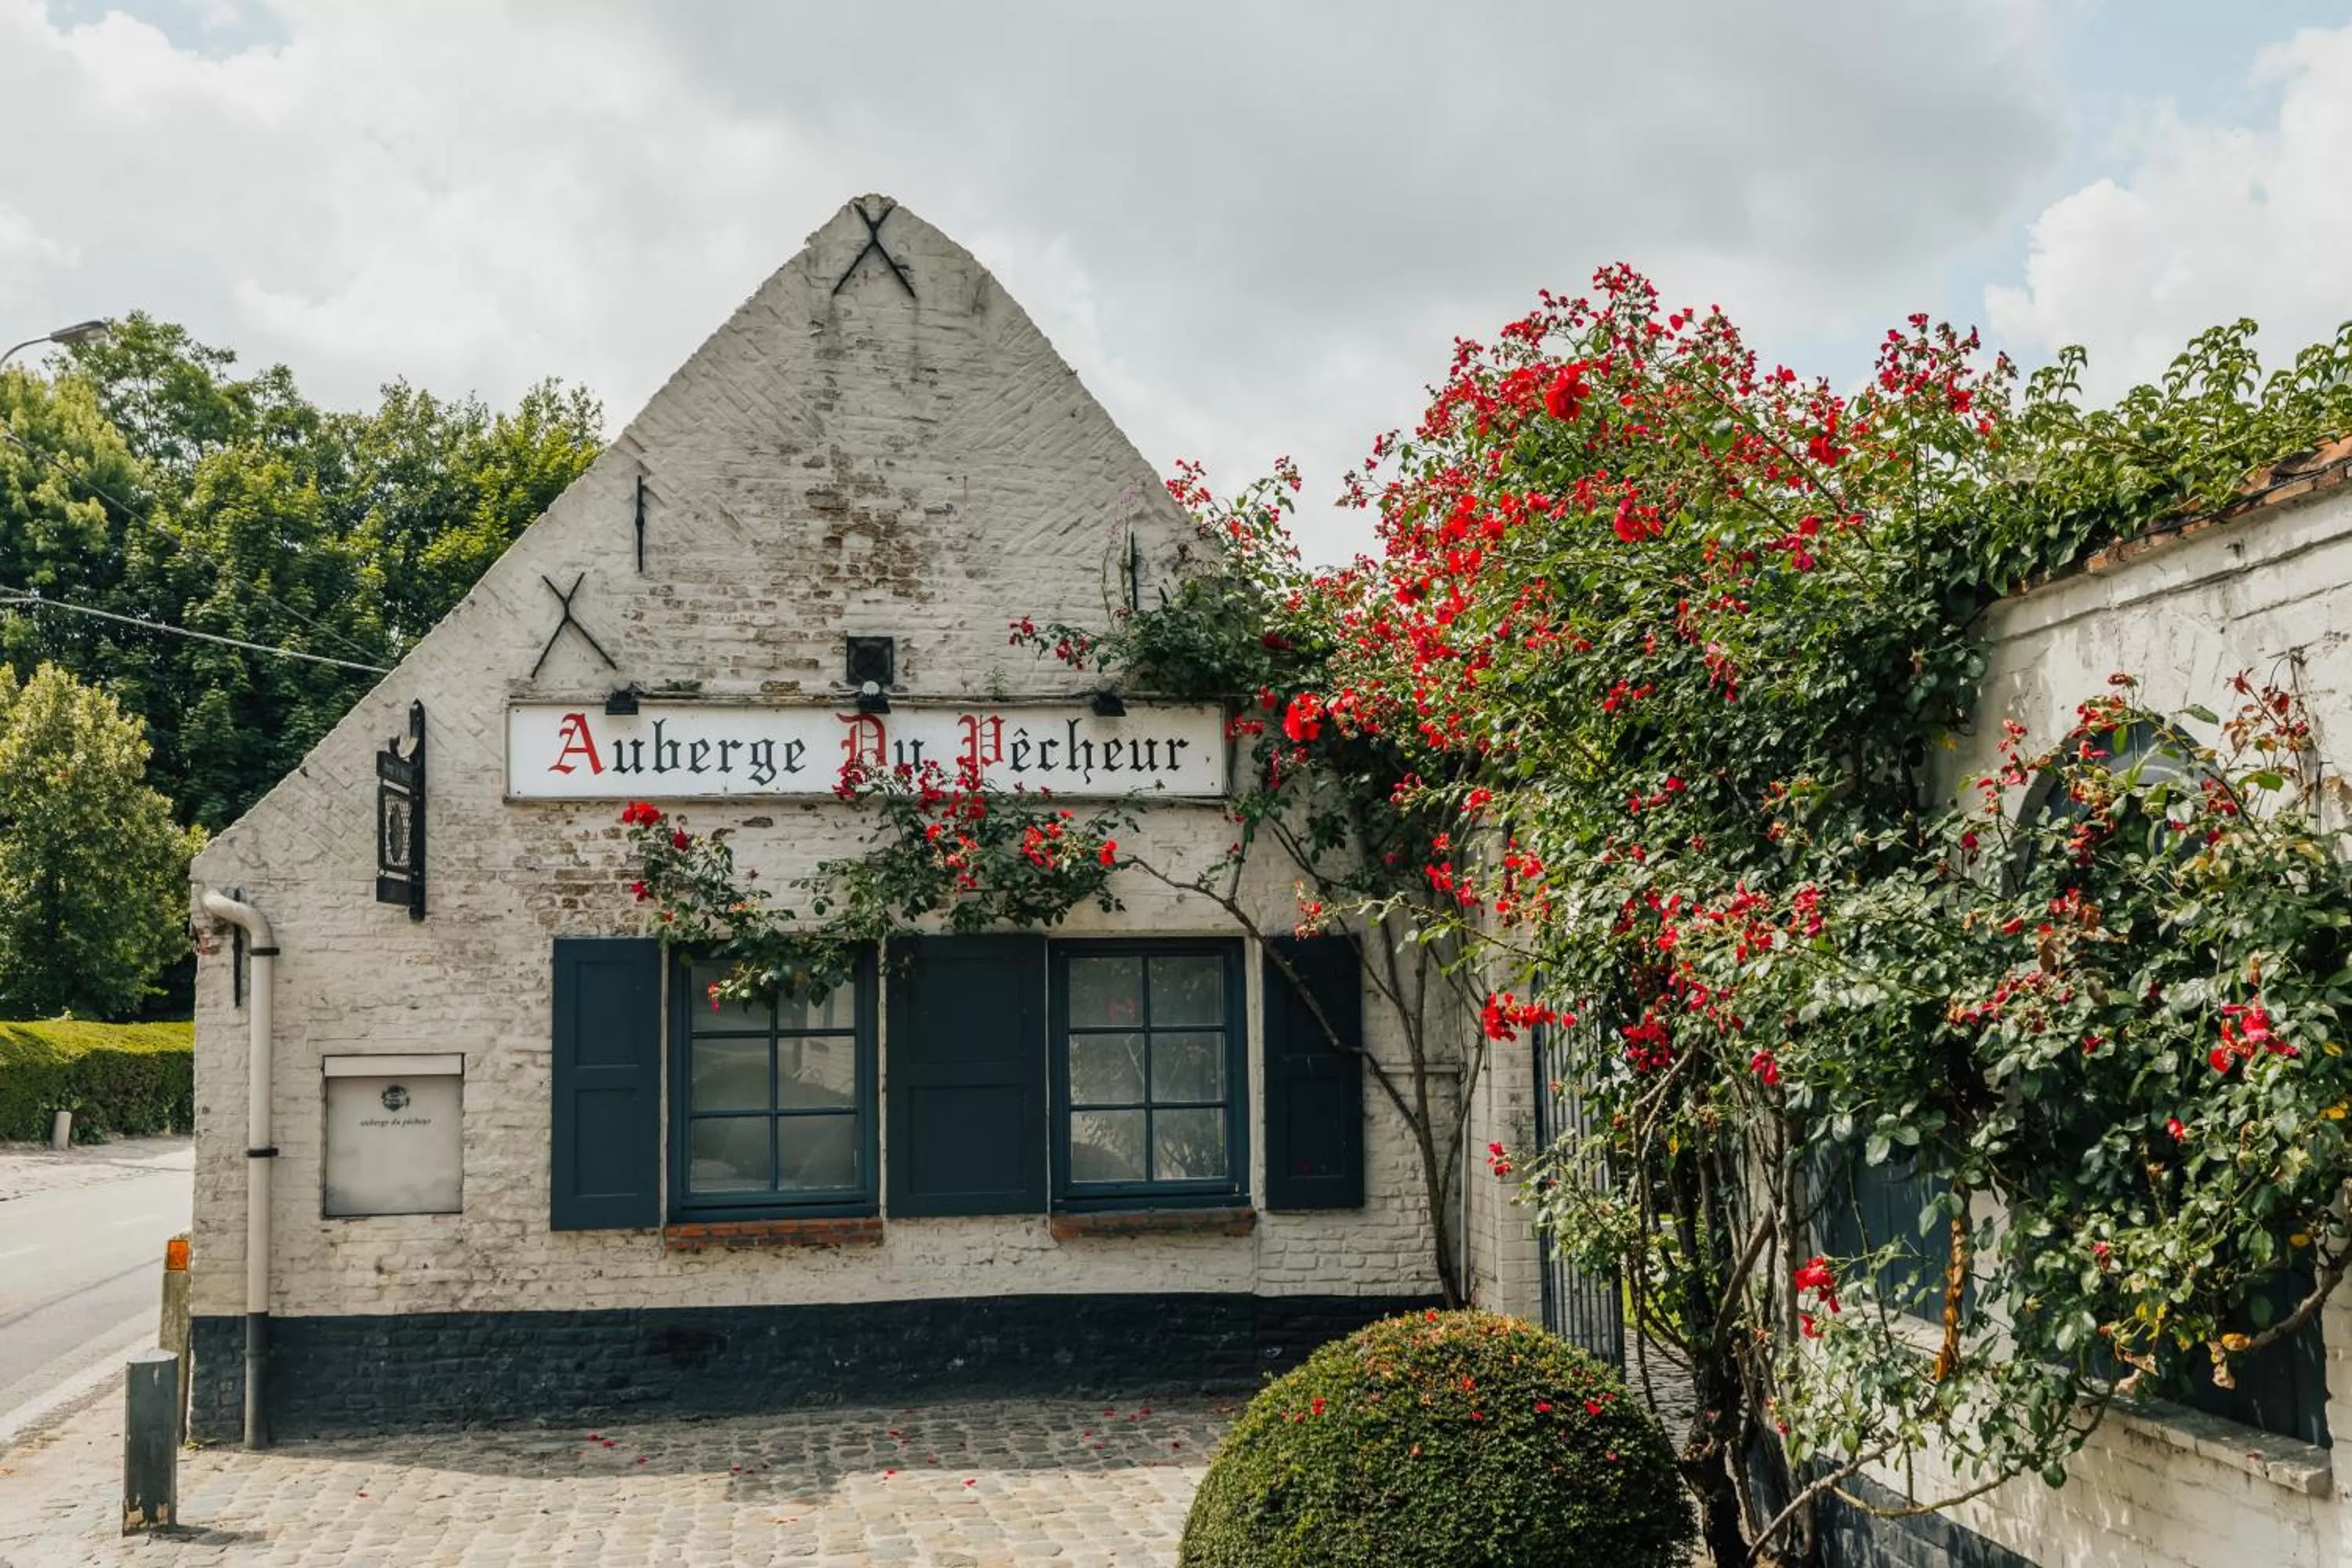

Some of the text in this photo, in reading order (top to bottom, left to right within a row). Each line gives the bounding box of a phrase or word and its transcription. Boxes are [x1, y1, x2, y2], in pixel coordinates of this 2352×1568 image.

[548, 712, 1189, 786] Auberge Du Pêcheur
